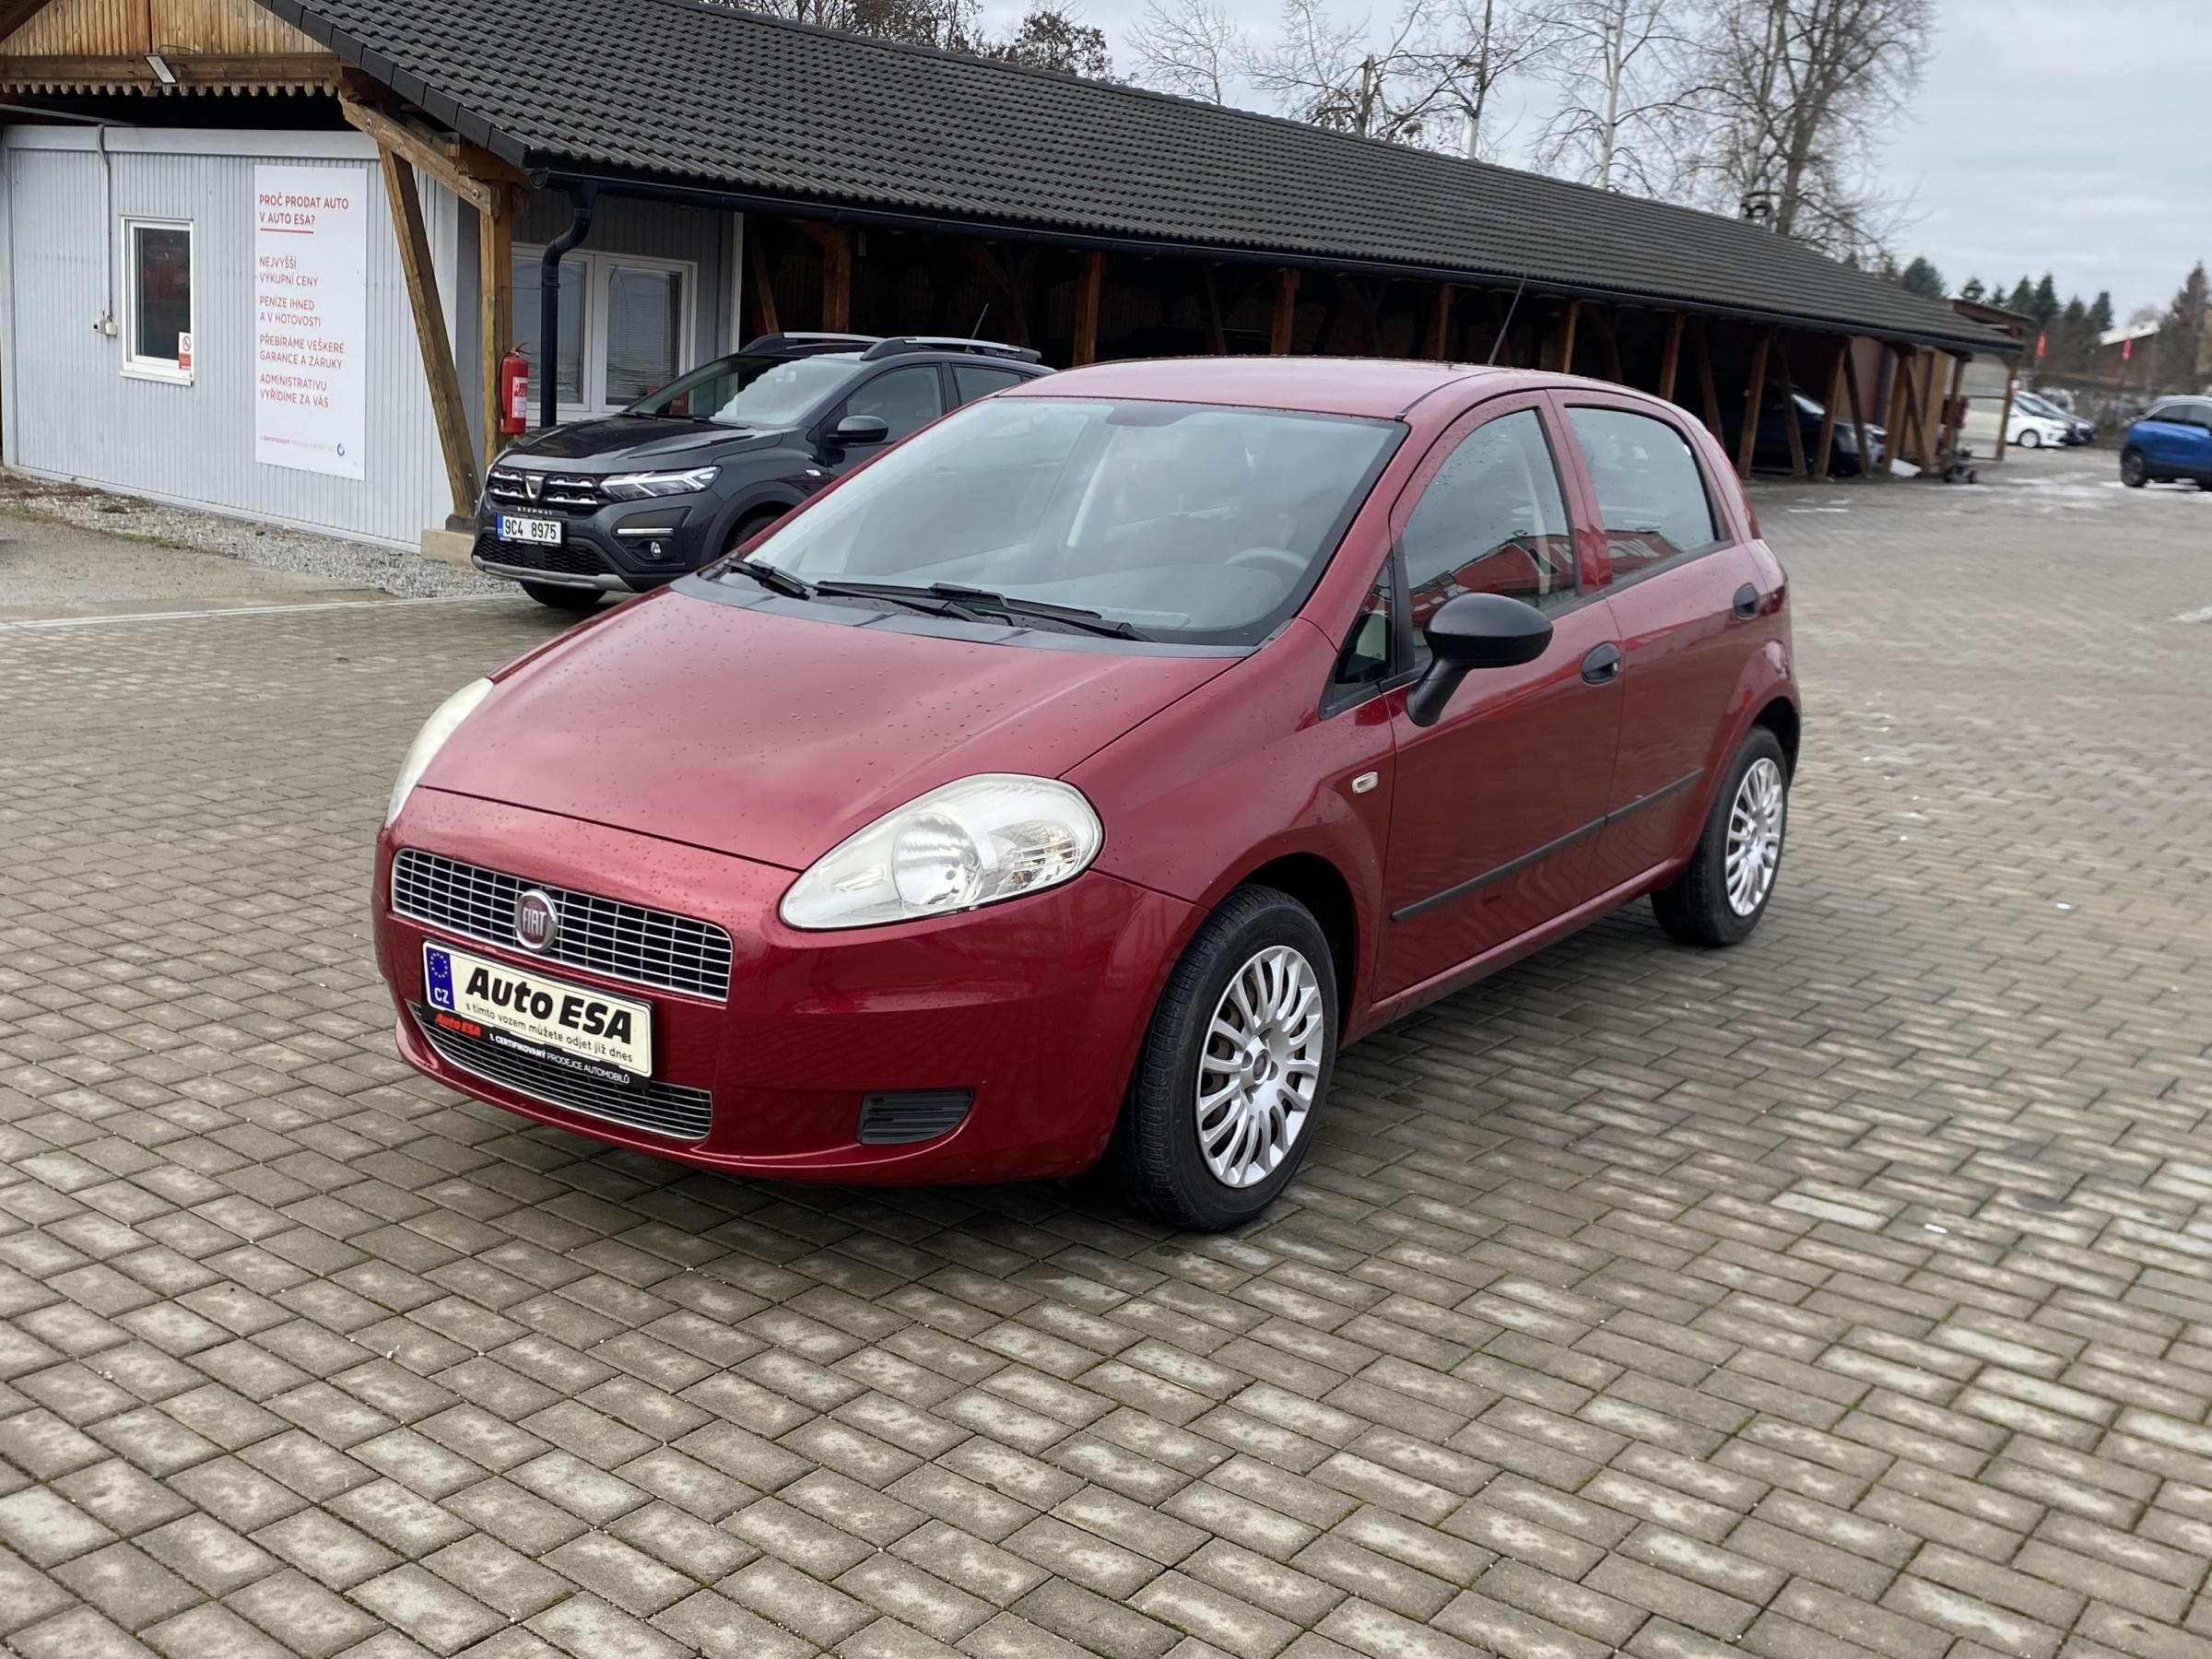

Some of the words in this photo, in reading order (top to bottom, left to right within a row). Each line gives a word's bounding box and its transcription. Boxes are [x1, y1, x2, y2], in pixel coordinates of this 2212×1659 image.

[259, 192, 283, 206] PROČ
[285, 195, 321, 208] PRODAT
[324, 197, 349, 210] AUTO
[259, 212, 265, 223] V
[267, 213, 292, 224] AUTO
[294, 214, 315, 226] ESA?
[259, 255, 297, 269] NEJVYŠŠÍ
[296, 276, 318, 288] CENY
[259, 294, 288, 308] PENÍZE
[289, 299, 315, 311] IHNED
[260, 312, 265, 323] A
[267, 312, 274, 324] V
[275, 313, 322, 328] HOTOVOSTI
[260, 350, 299, 365] GARANCE
[300, 355, 306, 365] A
[309, 354, 343, 370] ZÁRUKY
[260, 373, 327, 392] ADMINISTRATIVU
[299, 394, 311, 405] ZA
[312, 394, 329, 408] VÁS
[504, 519, 524, 536] 9C4
[531, 522, 557, 540] 8975
[523, 907, 547, 937] FIAT
[434, 987, 450, 1005] CZ
[558, 994, 631, 1045] ESA
[461, 1021, 481, 1037] ESA
[466, 1003, 471, 1011] s
[498, 1014, 526, 1030] vozem
[566, 1036, 592, 1051] odjet
[609, 1047, 632, 1063] dnes
[547, 1052, 582, 1071] PRODEJCE
[583, 1064, 630, 1085] AUTOMOBILŮ
